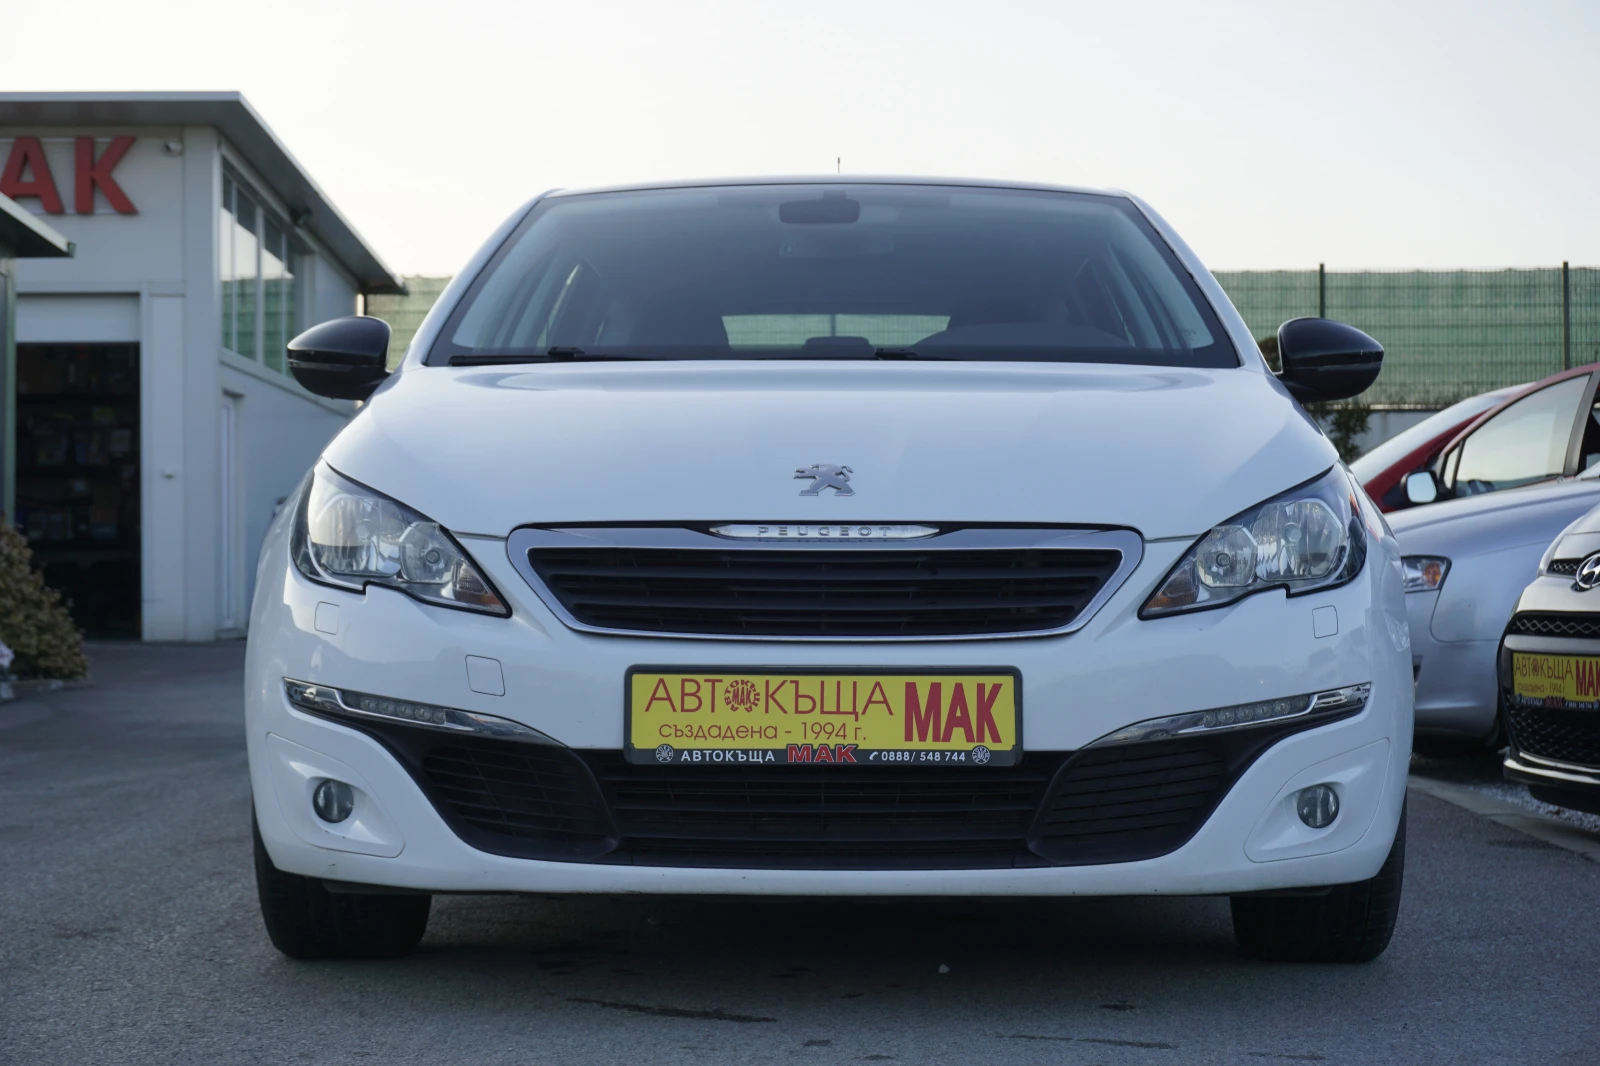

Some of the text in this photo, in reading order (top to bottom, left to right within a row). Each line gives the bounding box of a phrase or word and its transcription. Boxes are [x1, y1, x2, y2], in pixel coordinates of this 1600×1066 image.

[757, 525, 891, 537] PEUGEOT
[904, 681, 1003, 744] МАК
[658, 723, 778, 741] създадена
[801, 721, 848, 741] 1994
[680, 750, 776, 763] АВТОКЪЩА
[787, 744, 858, 763] МАК
[881, 751, 916, 762] 0888/
[919, 751, 941, 761] 548
[944, 751, 966, 762] 744
